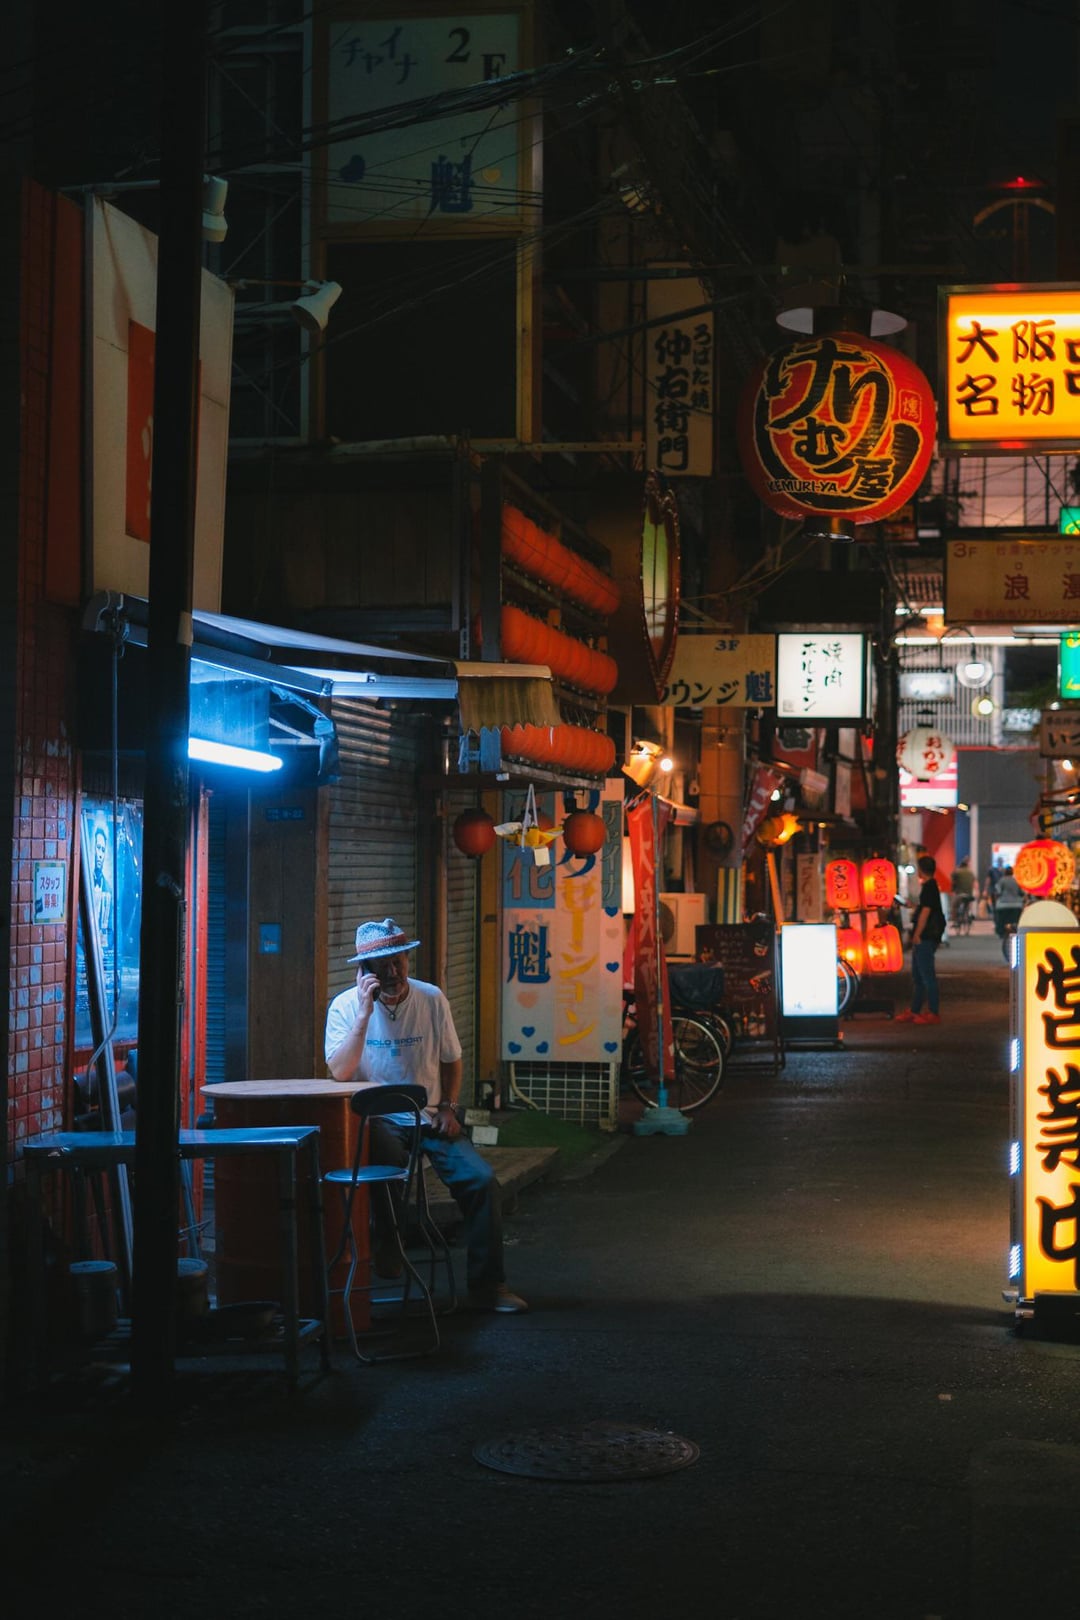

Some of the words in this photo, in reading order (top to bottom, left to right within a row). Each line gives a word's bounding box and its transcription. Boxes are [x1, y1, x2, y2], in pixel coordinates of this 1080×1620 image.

[340, 26, 418, 85] チャイナ
[956, 320, 1056, 363] 大阪
[956, 373, 1054, 416] 名物
[768, 479, 838, 494] KEMURI-YA
[953, 543, 977, 558] 3F
[715, 640, 740, 651] 3F
[801, 640, 817, 712] ホルモン
[40, 877, 61, 890] スタッフ
[394, 1036, 423, 1044] SPORT
